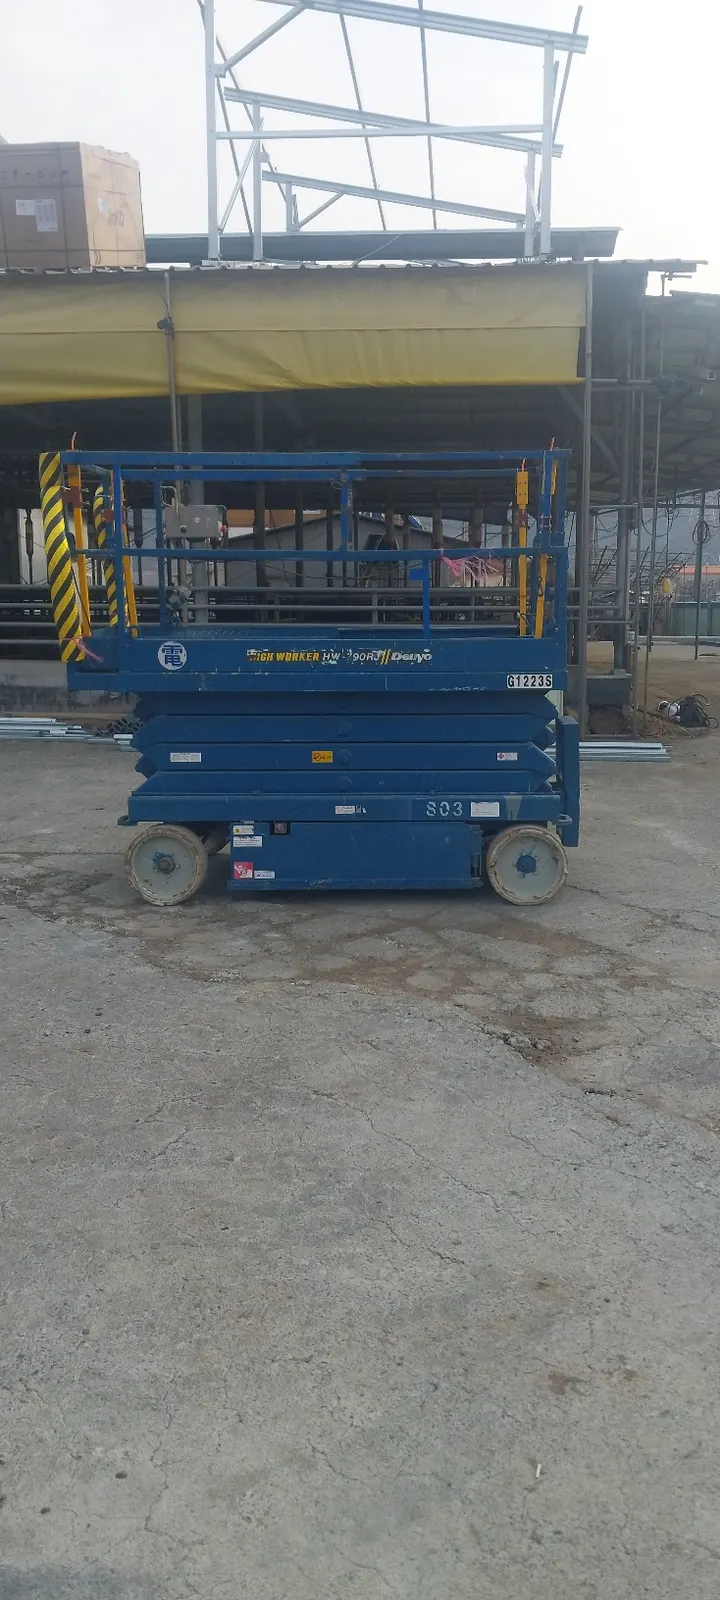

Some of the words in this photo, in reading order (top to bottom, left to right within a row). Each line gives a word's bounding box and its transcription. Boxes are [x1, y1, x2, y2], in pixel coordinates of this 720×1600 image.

[161, 644, 183, 667] 電
[276, 652, 319, 662] WORKER
[507, 675, 552, 688] G1223S
